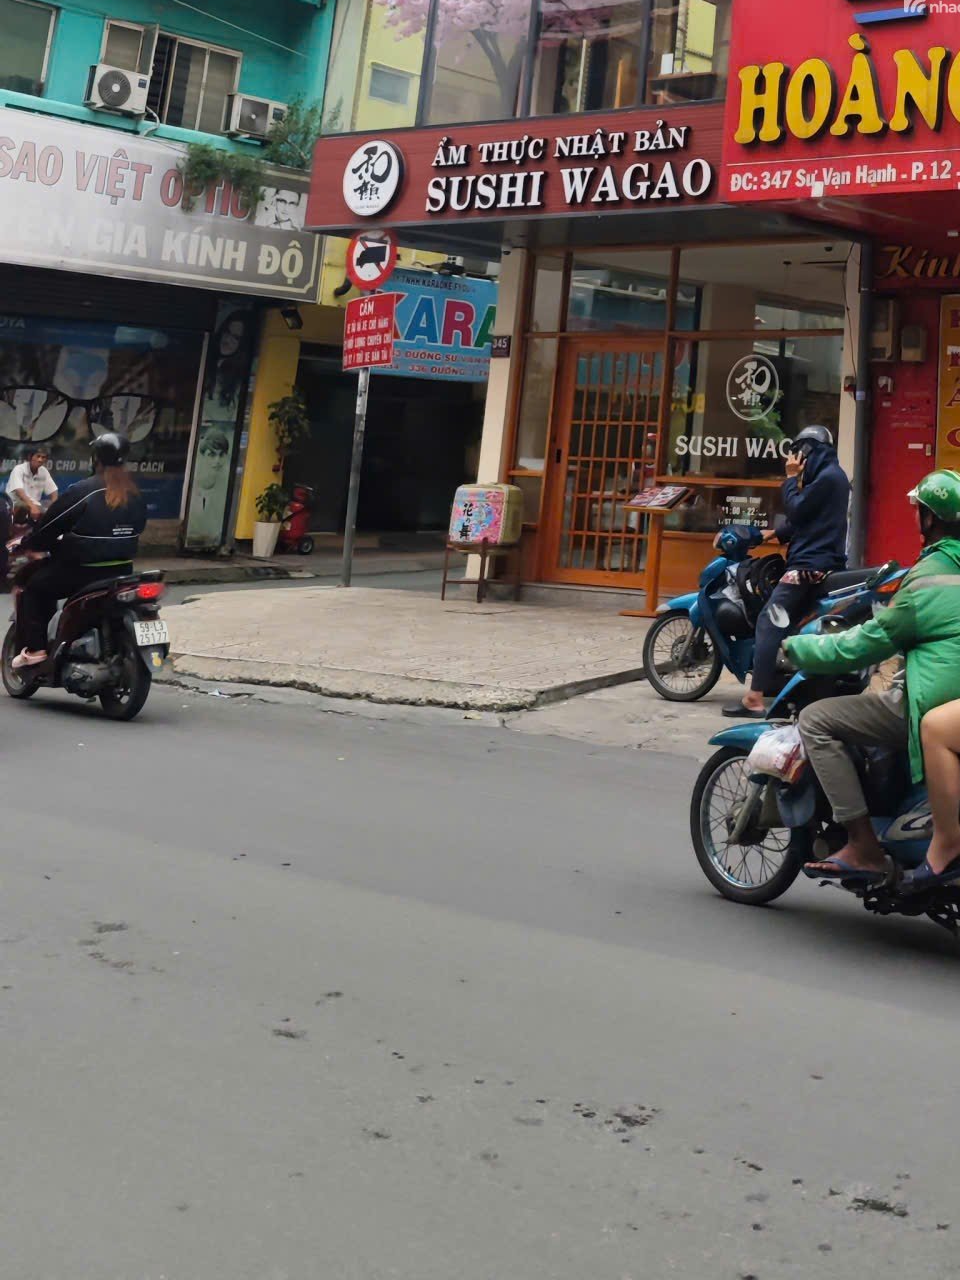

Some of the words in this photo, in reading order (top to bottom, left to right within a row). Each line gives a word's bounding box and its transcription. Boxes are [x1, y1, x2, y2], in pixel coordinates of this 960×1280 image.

[431, 136, 467, 167] ẨM
[479, 135, 544, 165] THỰC
[554, 128, 624, 161] NHẬT
[633, 119, 687, 153] BẢN
[0, 136, 63, 186] SAO
[75, 148, 152, 205] VIỆT
[730, 173, 758, 192] ĐC:
[761, 170, 790, 189] 347
[823, 167, 850, 190] Vạn
[425, 171, 545, 212] SUSHI
[559, 158, 712, 204] WAGAO
[90, 223, 147, 258] GIA
[161, 227, 248, 272] KÍNH
[258, 240, 304, 284] ĐỘ
[359, 298, 374, 317] CẤM
[493, 337, 507, 348] 345
[675, 436, 738, 458] SUSHI
[56, 460, 76, 472] CHO
